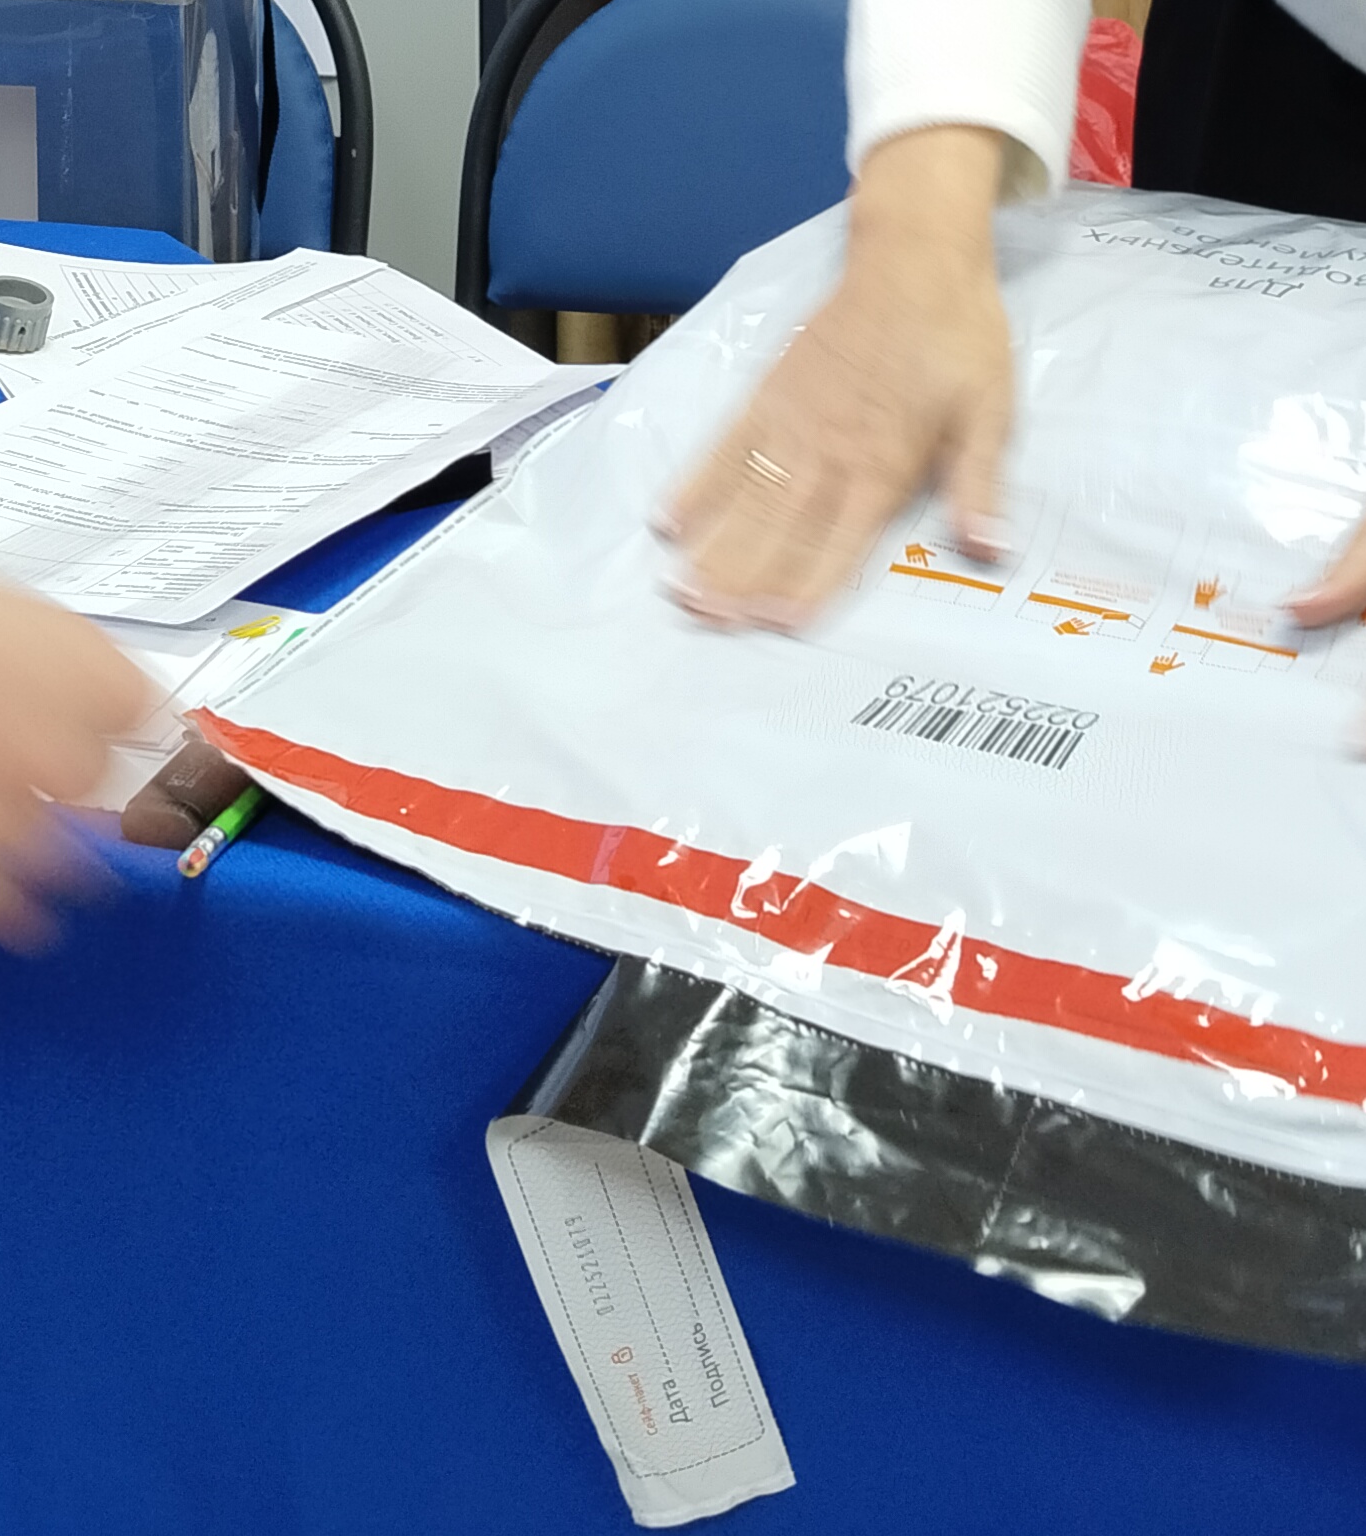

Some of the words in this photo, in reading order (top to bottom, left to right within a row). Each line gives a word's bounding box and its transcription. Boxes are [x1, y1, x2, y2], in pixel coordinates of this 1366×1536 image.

[1209, 275, 1305, 299] Для
[884, 674, 1100, 731] 022521079
[564, 1214, 615, 1316] 022521079
[692, 1322, 730, 1408] Подпись
[663, 1379, 693, 1424] Дата
